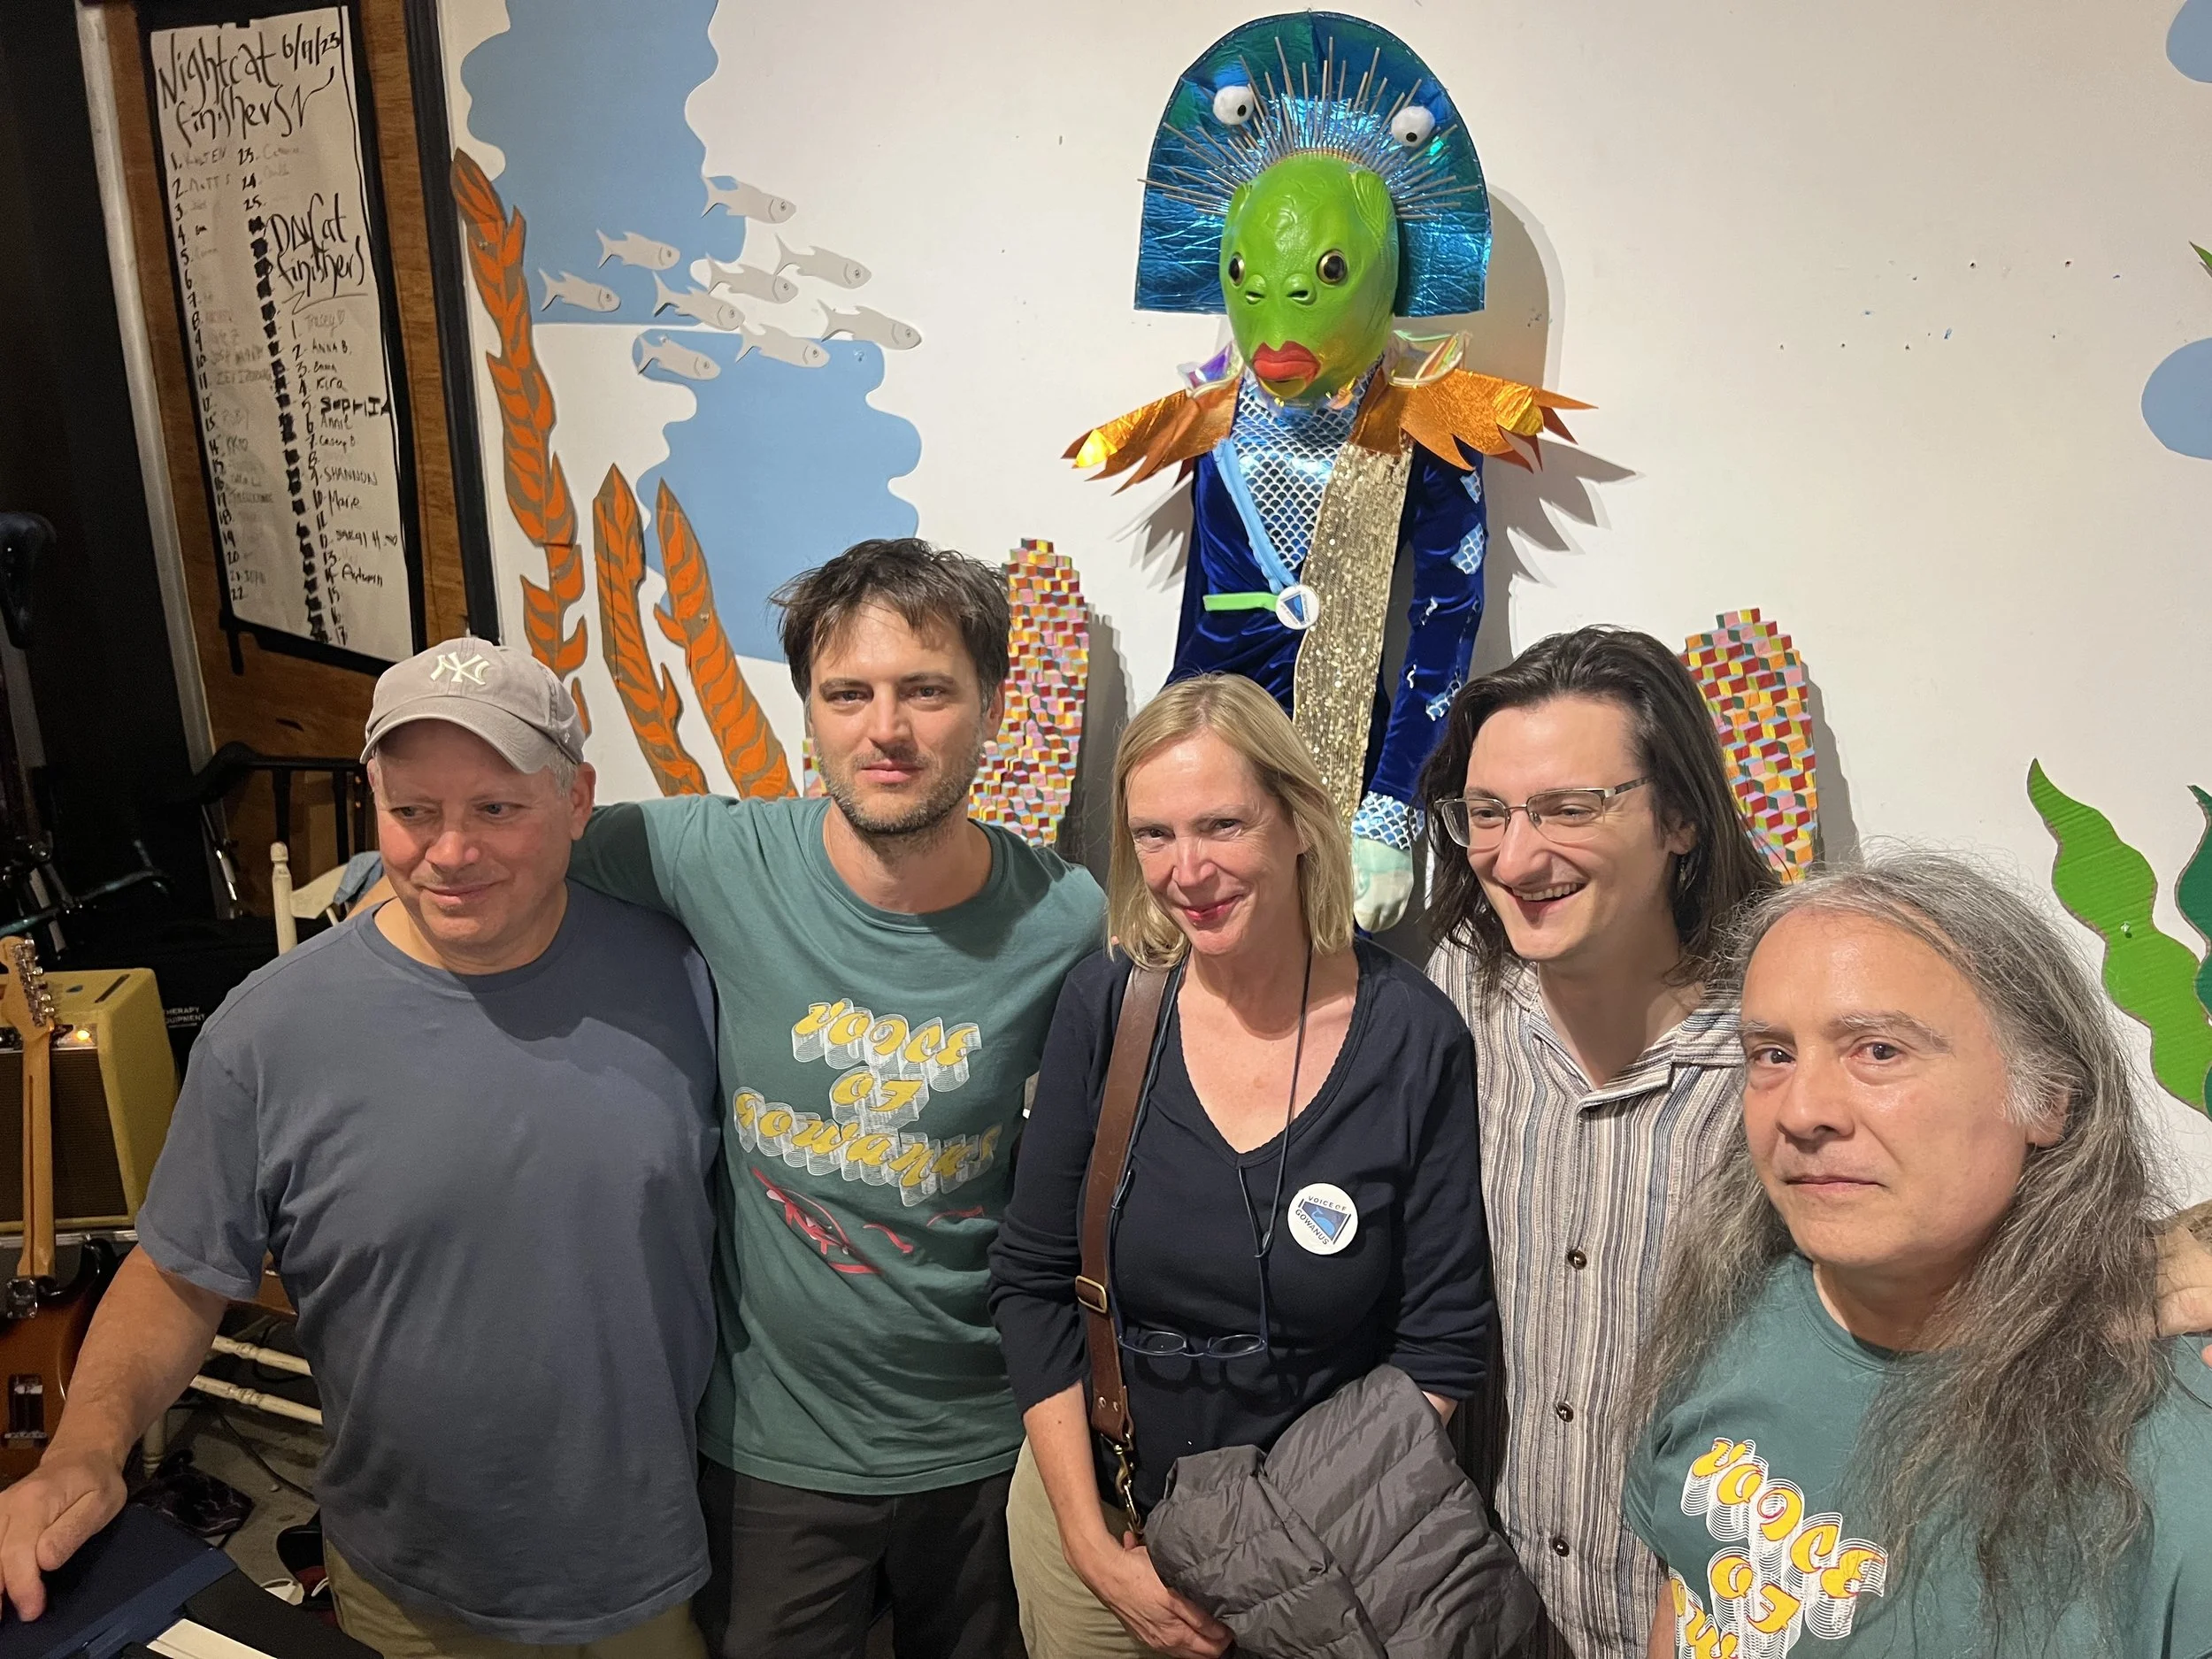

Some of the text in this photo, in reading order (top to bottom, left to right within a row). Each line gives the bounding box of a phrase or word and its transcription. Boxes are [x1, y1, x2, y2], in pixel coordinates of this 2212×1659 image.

[430, 651, 489, 686] NY
[1309, 1195, 1334, 1209] VOICE
[1295, 1209, 1330, 1245] GOWANUS
